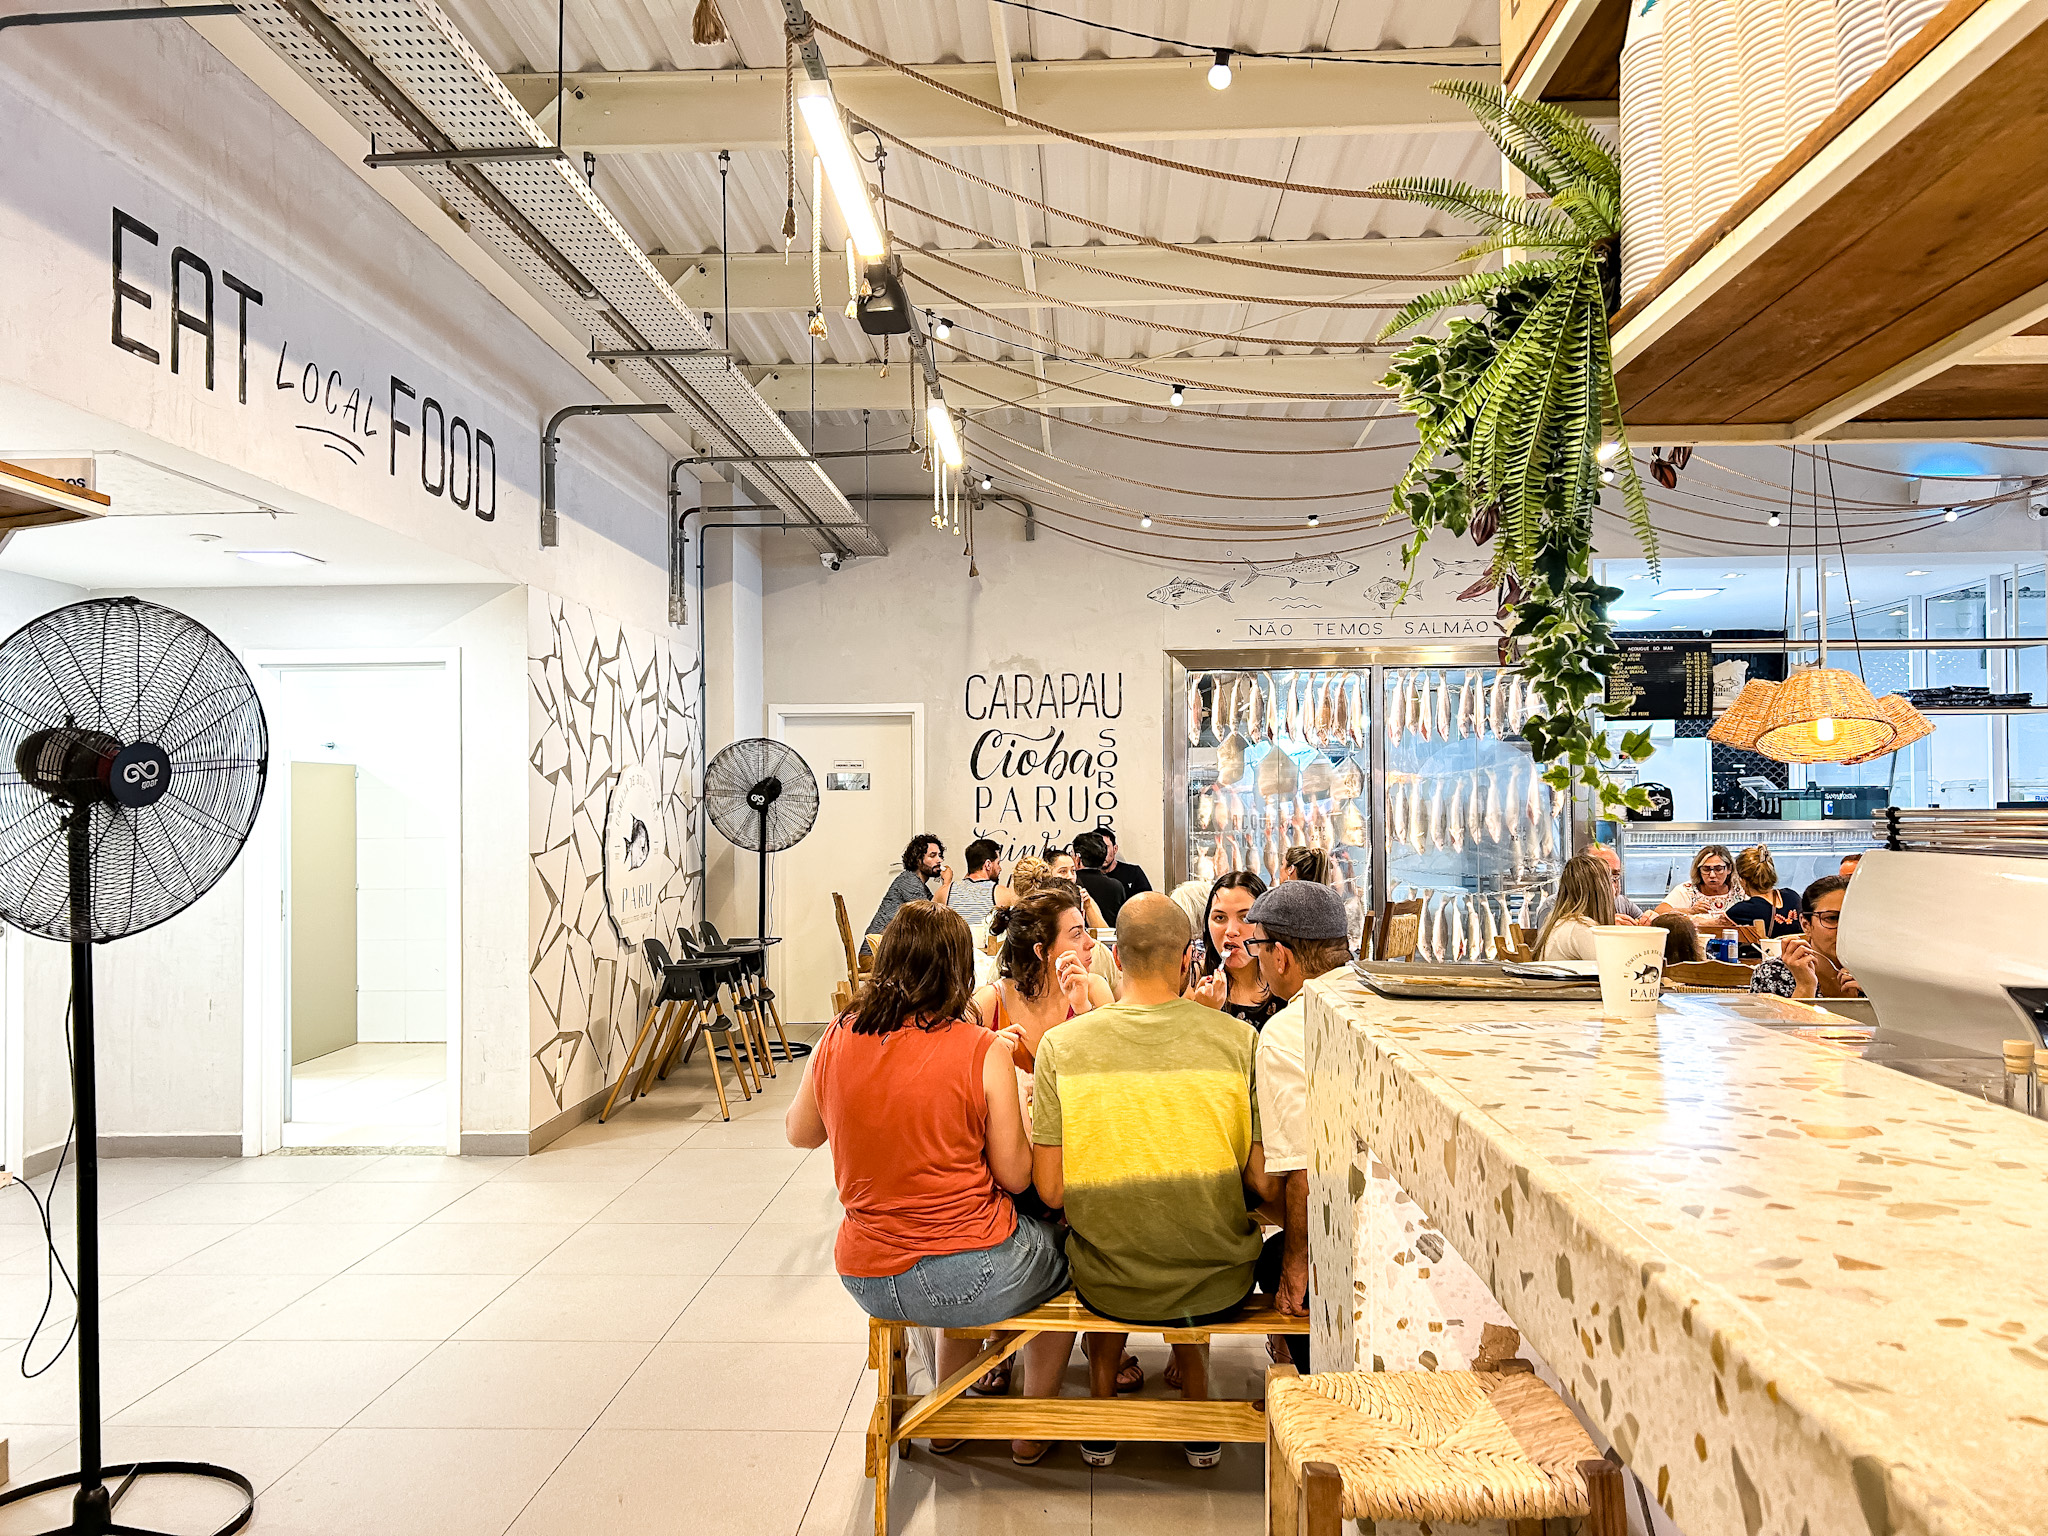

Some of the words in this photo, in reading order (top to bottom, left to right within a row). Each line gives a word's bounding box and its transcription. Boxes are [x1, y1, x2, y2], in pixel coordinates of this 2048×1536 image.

[111, 206, 263, 405] EAT
[276, 341, 377, 437] LOCAL
[390, 374, 496, 523] FOOD
[1249, 621, 1293, 637] NÃO
[1313, 622, 1384, 636] TEMOS
[1404, 618, 1489, 635] SALMÃO
[965, 672, 1123, 720] CARAPAU
[970, 725, 1096, 781] Cioba
[976, 785, 1090, 823] PARU
[622, 883, 652, 912] PARU
